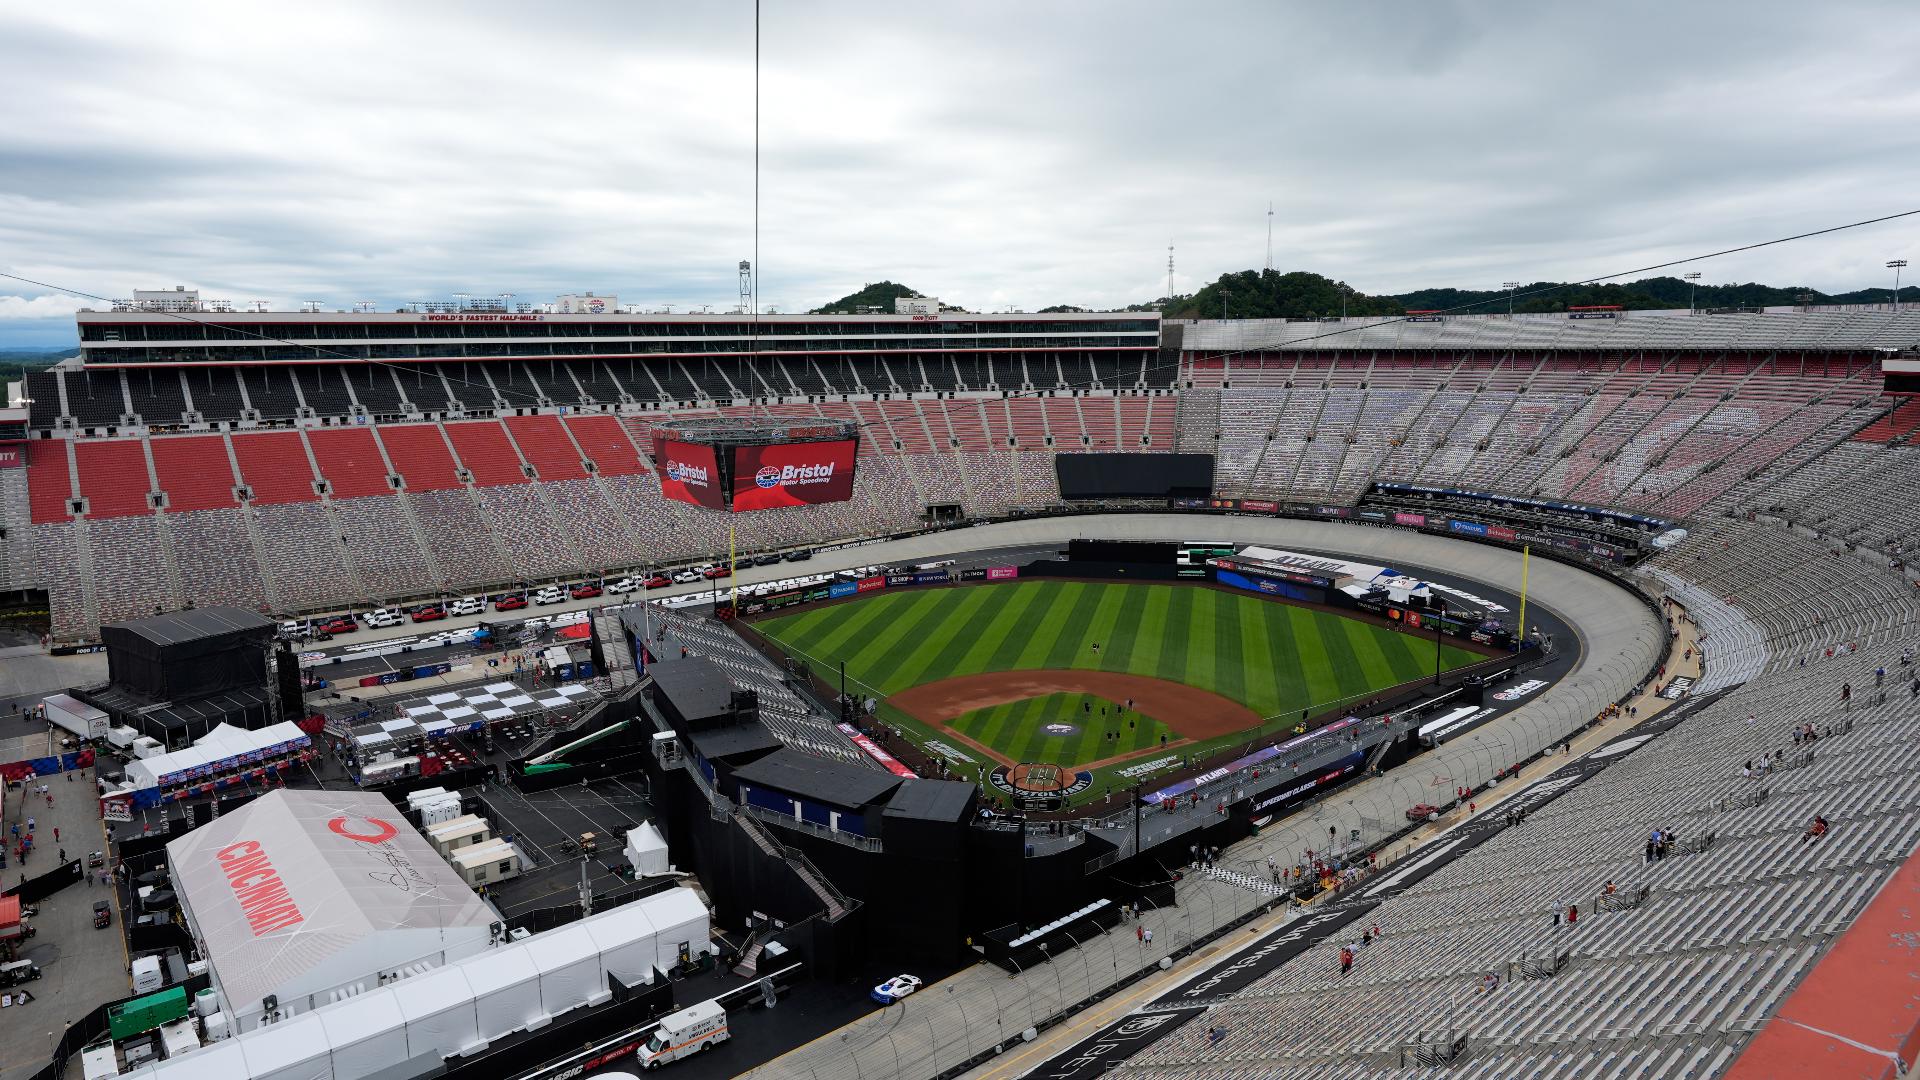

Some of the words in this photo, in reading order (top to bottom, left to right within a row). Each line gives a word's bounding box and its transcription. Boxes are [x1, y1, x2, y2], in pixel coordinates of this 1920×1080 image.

[678, 462, 708, 481] Bristol
[781, 461, 835, 480] Bristol
[779, 478, 800, 487] Motor
[799, 476, 831, 486] Speedway
[215, 840, 305, 937] CINCINNATI
[1183, 909, 1347, 998] Budweiser
